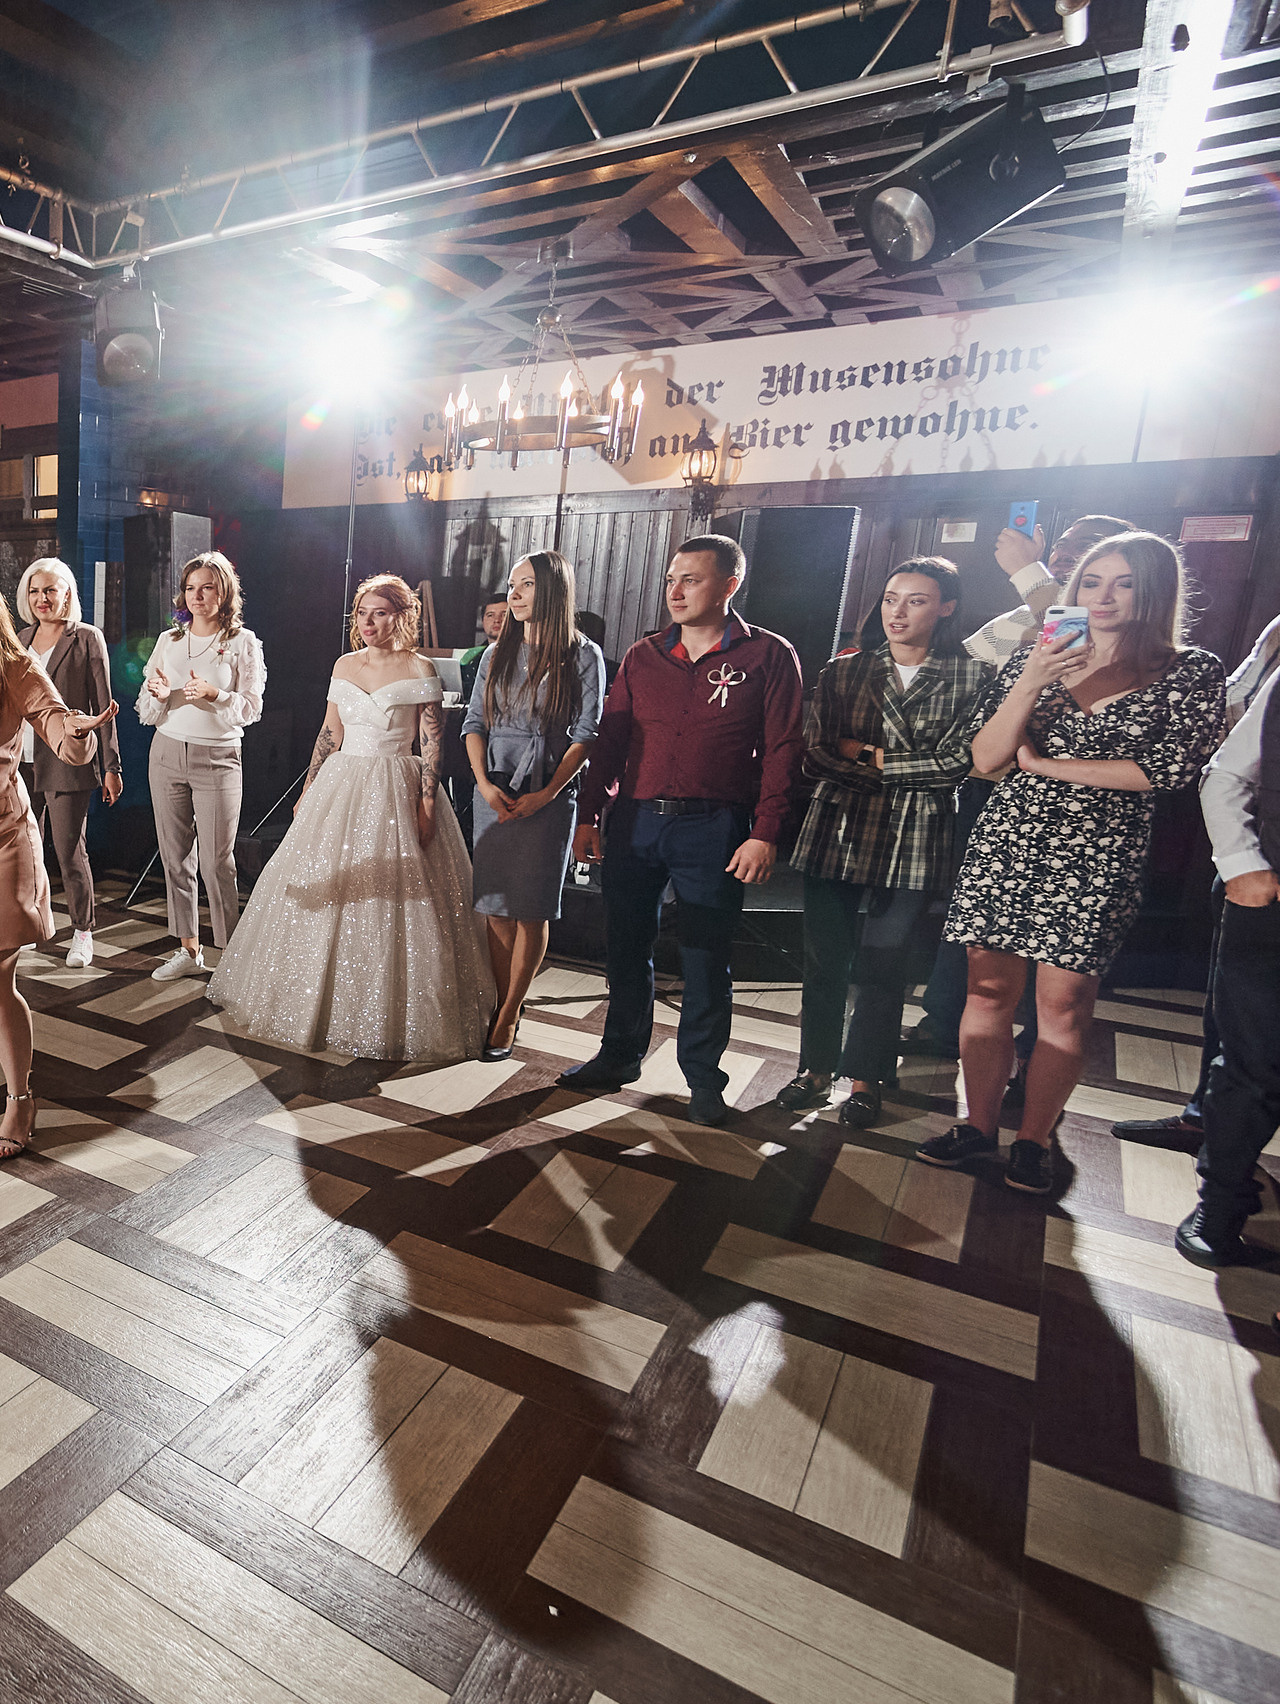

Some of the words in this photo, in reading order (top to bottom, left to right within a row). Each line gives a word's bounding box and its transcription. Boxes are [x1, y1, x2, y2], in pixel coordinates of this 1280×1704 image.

[664, 377, 725, 409] der
[757, 341, 1052, 406] Musensohne
[728, 417, 815, 459] Bier
[826, 400, 1039, 452] gewohne.
